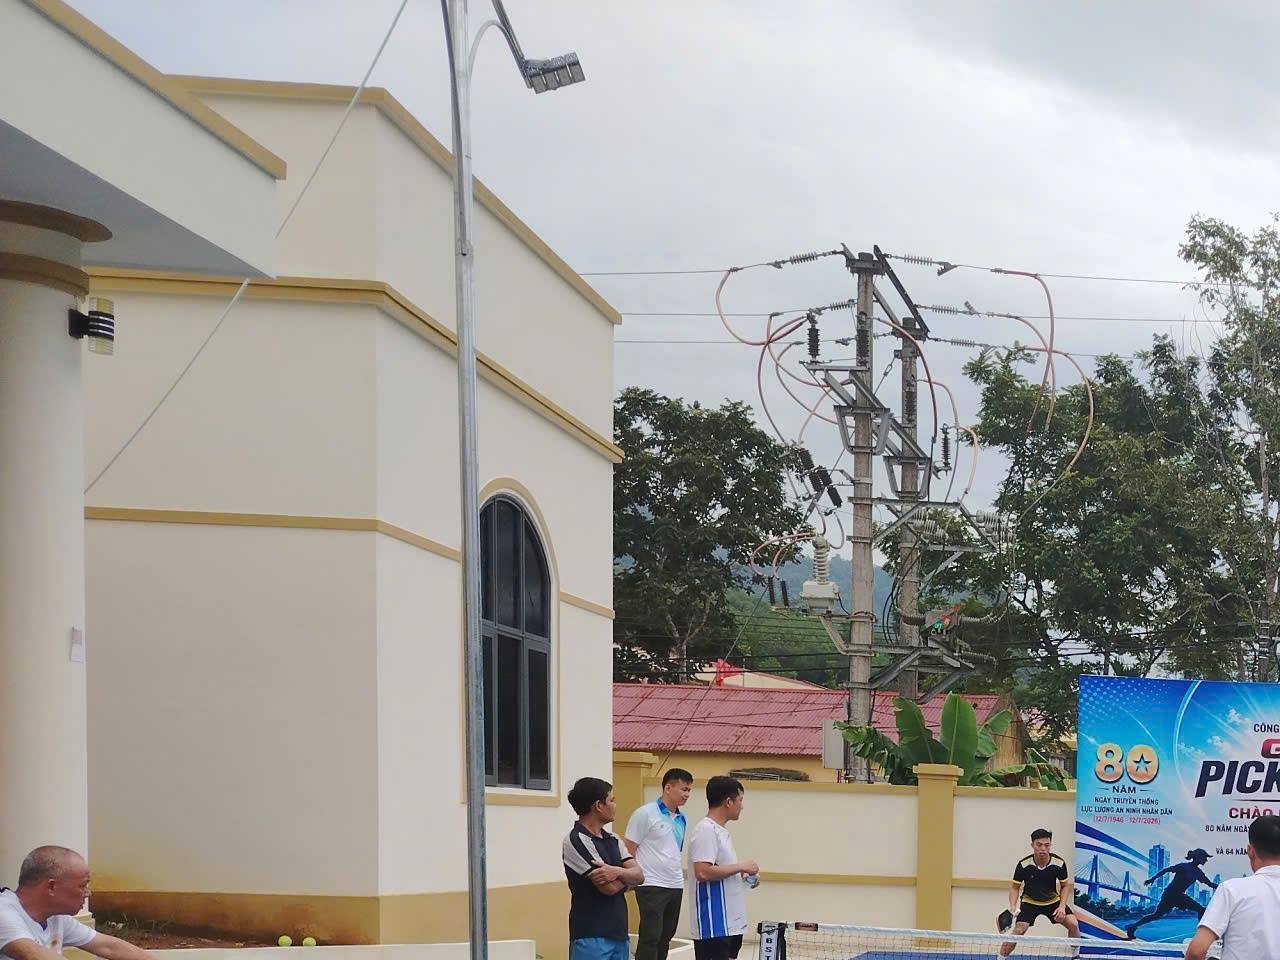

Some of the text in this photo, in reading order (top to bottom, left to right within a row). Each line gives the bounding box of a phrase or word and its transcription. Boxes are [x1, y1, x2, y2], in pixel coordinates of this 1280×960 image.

[1254, 723, 1280, 734] CÔNG
[1095, 743, 1159, 785] 80
[1112, 785, 1136, 794] NĂM
[1139, 797, 1159, 805] THỐNG
[1228, 806, 1273, 819] CHÀO
[1216, 824, 1232, 832] NĂM
[1215, 847, 1224, 855] VÀ
